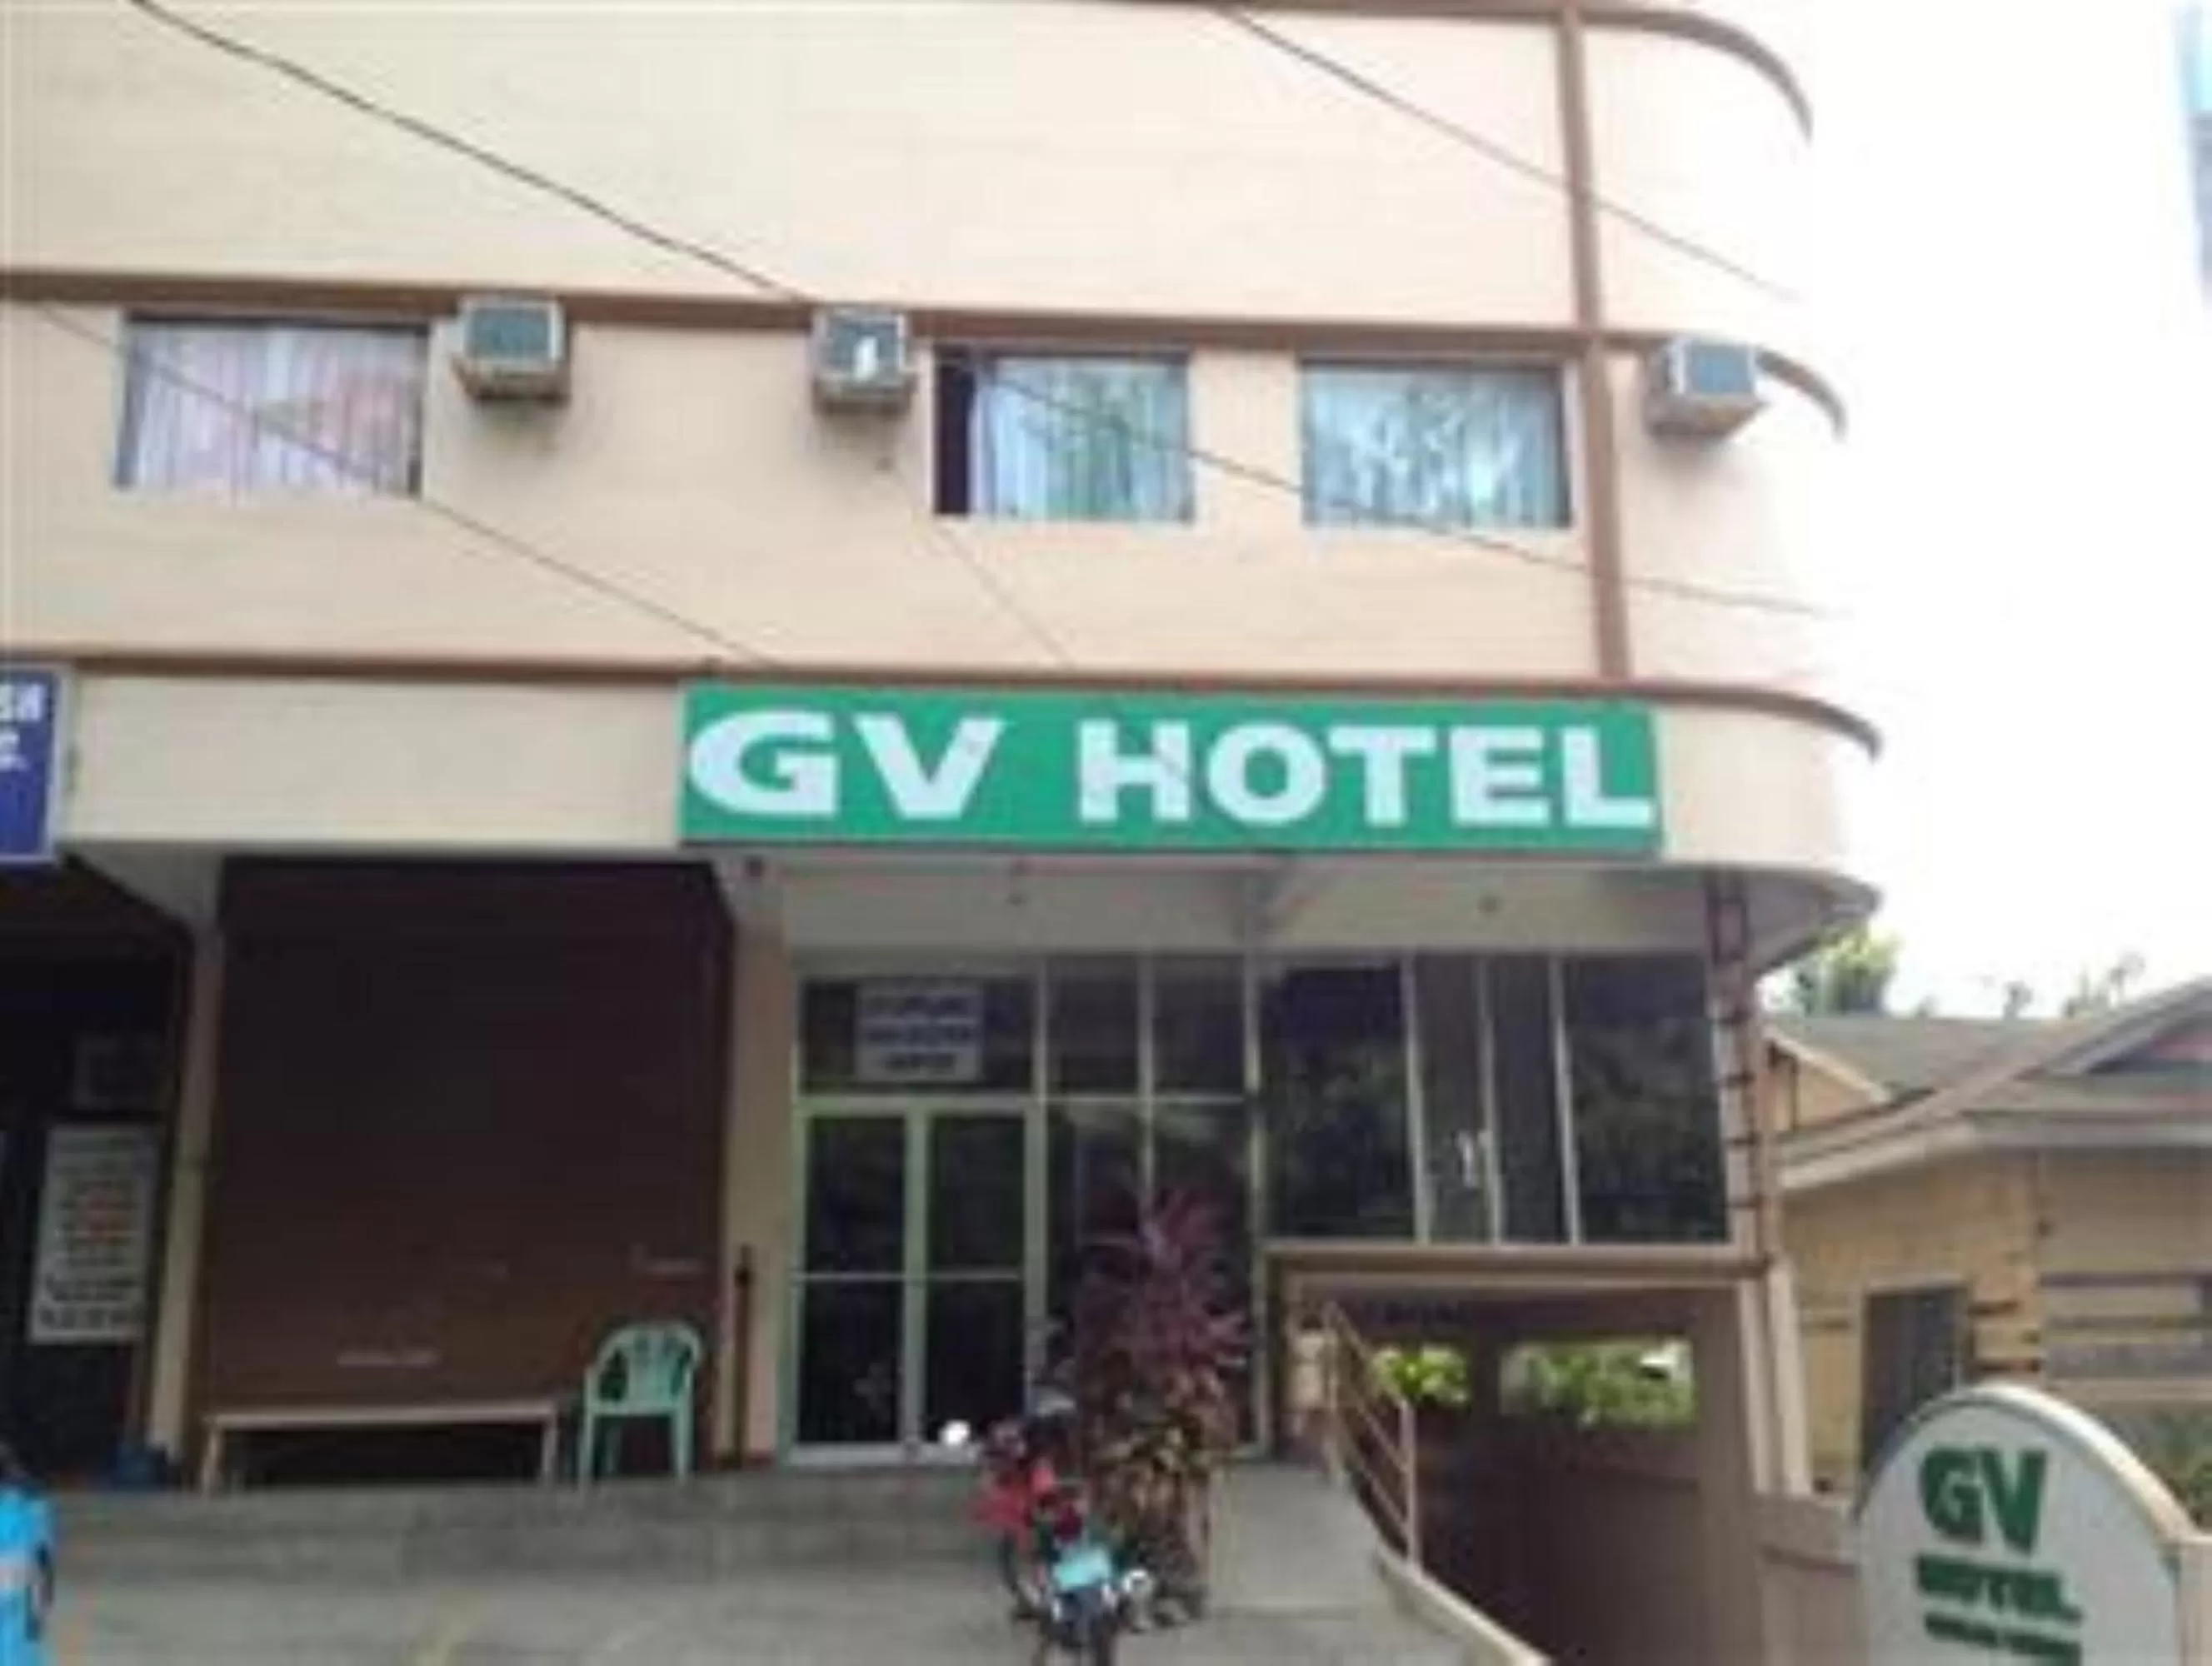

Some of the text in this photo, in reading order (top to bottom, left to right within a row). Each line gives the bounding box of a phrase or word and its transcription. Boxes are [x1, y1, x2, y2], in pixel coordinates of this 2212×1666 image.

[688, 709, 1655, 828] GV HOTEL
[1920, 1445, 2048, 1555] GV
